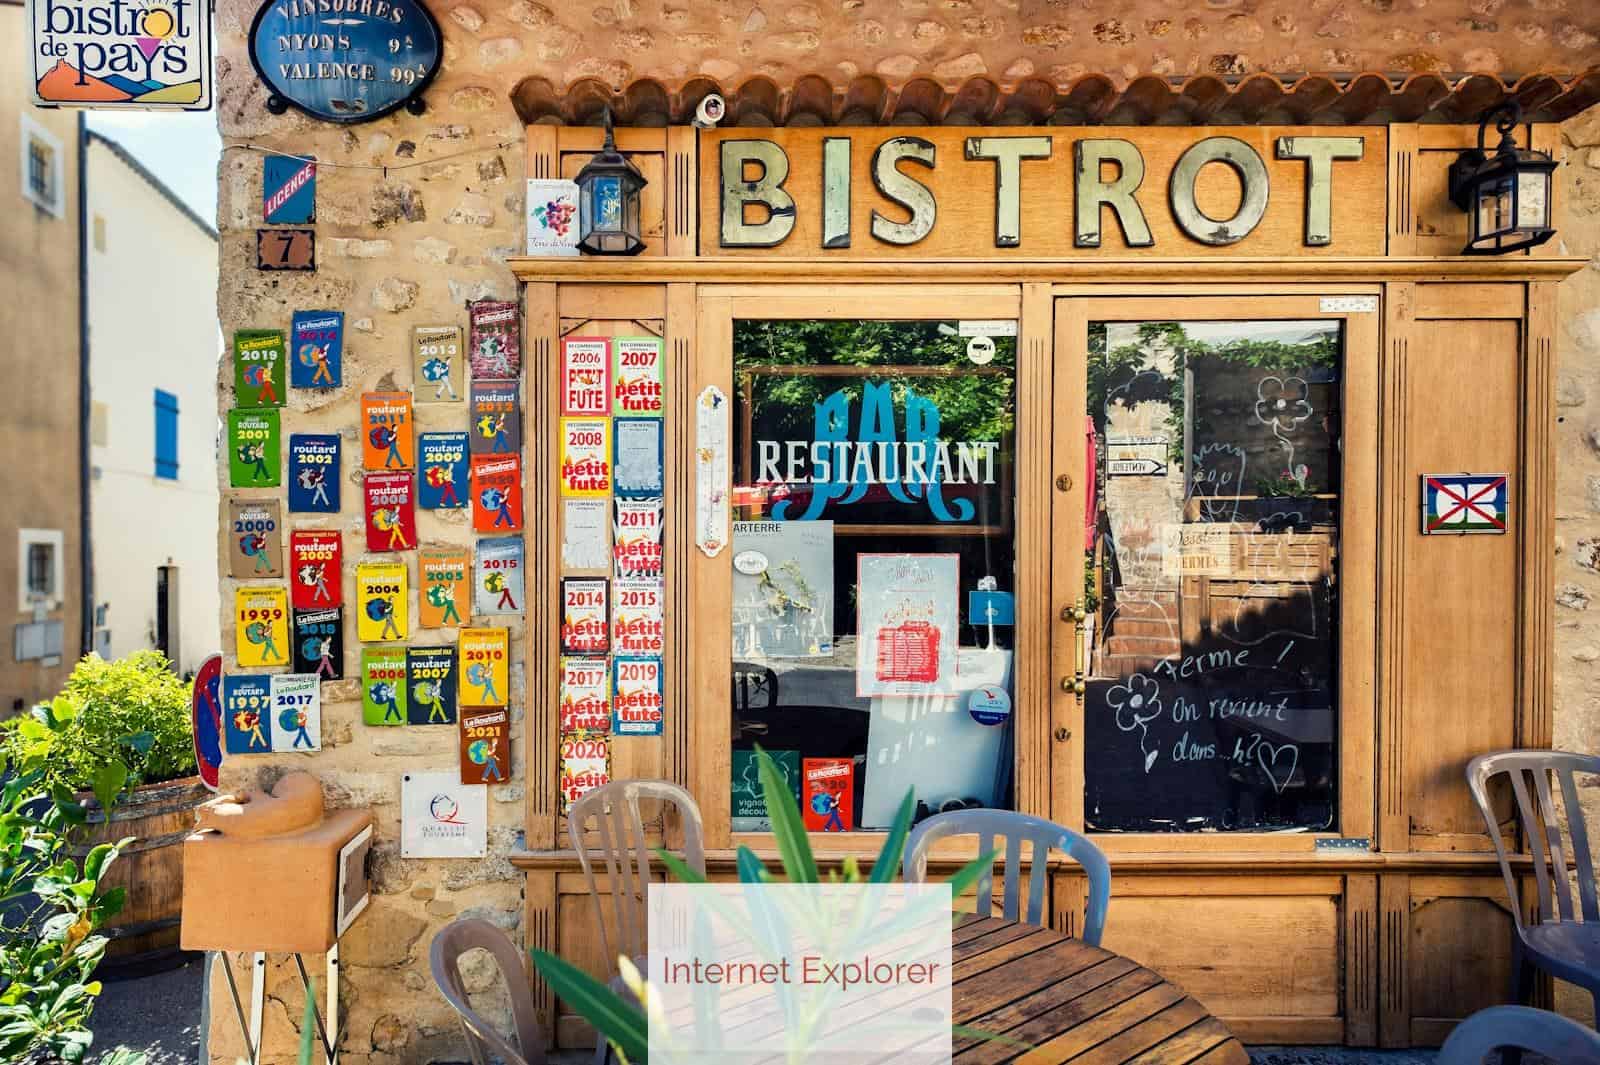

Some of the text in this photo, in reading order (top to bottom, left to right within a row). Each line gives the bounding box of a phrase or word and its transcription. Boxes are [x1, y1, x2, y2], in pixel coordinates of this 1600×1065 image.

[277, 0, 405, 24] VINSOBRES
[42, 0, 191, 38] bistrot
[279, 34, 350, 52] NYONS
[40, 35, 188, 86] de pays
[279, 63, 376, 81] VALENCE
[267, 163, 313, 216] LICENCE
[719, 135, 1365, 249] BISTROT
[278, 236, 294, 263] 7
[241, 350, 278, 360] 2019
[419, 345, 457, 355] 2013
[571, 352, 601, 363] 2006
[621, 352, 657, 366] 2007
[614, 381, 662, 399] petit
[474, 393, 515, 403] routard
[366, 404, 407, 414] routard
[476, 402, 513, 412] 2012
[369, 414, 405, 424] 2011
[237, 430, 270, 440] 2001
[568, 432, 602, 446] 2008
[293, 445, 337, 454] routard
[424, 444, 464, 453] routard
[770, 380, 976, 522] BAR
[297, 454, 333, 464] 2002
[425, 453, 463, 463] 2009
[756, 440, 1000, 485] RESTAURANT
[561, 461, 608, 479] petit
[369, 485, 409, 496] routard
[620, 512, 655, 526] 2011
[235, 521, 275, 532] 2000
[294, 543, 338, 552] routard
[614, 541, 662, 560] petit
[299, 551, 333, 561] 2003
[424, 562, 464, 571] routard
[483, 559, 518, 569] 2015
[427, 571, 464, 581] 2005
[366, 585, 400, 594] 2004
[567, 591, 604, 606] 2014
[620, 591, 656, 606] 2015
[240, 609, 282, 621] 1999
[300, 624, 336, 634] 2018
[561, 620, 609, 640] petit
[614, 621, 662, 639] petit
[466, 650, 503, 660] 2010
[367, 660, 406, 669] routard
[411, 659, 451, 668] routard
[368, 670, 406, 679] 2006
[412, 668, 450, 679] 2007
[567, 671, 604, 685] 2017
[619, 664, 657, 680] 2019
[228, 696, 271, 709] 1997
[277, 695, 313, 705] 2017
[613, 692, 662, 710] petit
[561, 700, 610, 720] petit
[1172, 697, 1289, 723] On revient
[466, 726, 501, 738] 2021
[563, 741, 607, 759] 2020
[1172, 731, 1216, 762] dans
[561, 773, 609, 791] petit
